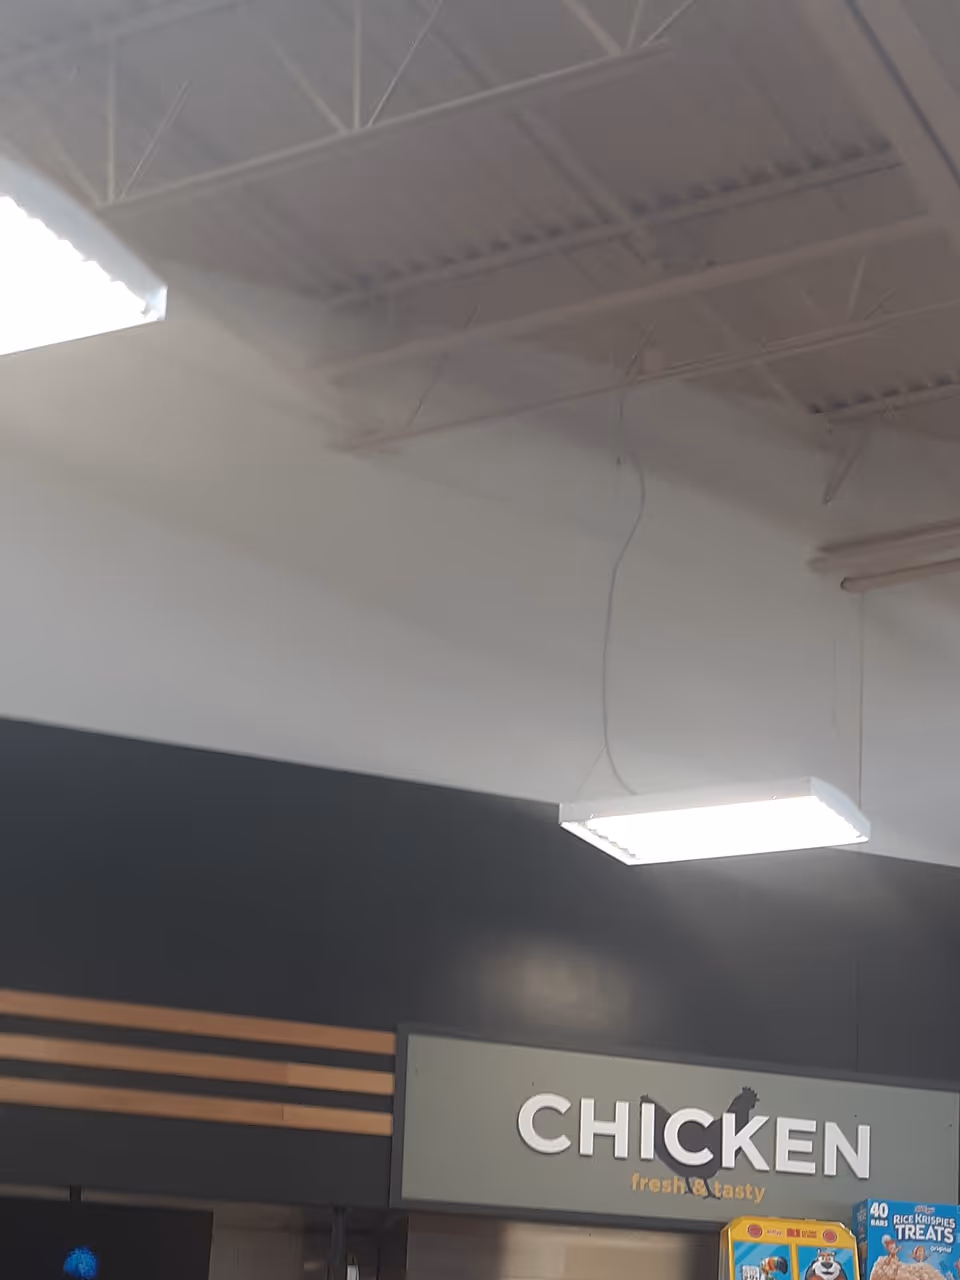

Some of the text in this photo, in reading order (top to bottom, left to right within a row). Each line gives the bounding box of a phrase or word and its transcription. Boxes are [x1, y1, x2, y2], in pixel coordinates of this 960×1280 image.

[517, 1092, 871, 1179] CHICKEN
[631, 1173, 685, 1194] fresh
[714, 1182, 766, 1204] tasty
[870, 1202, 888, 1218] 40
[871, 1219, 888, 1227] BARS
[893, 1213, 956, 1229] RICE KRISPIES
[894, 1224, 954, 1244] TREATS
